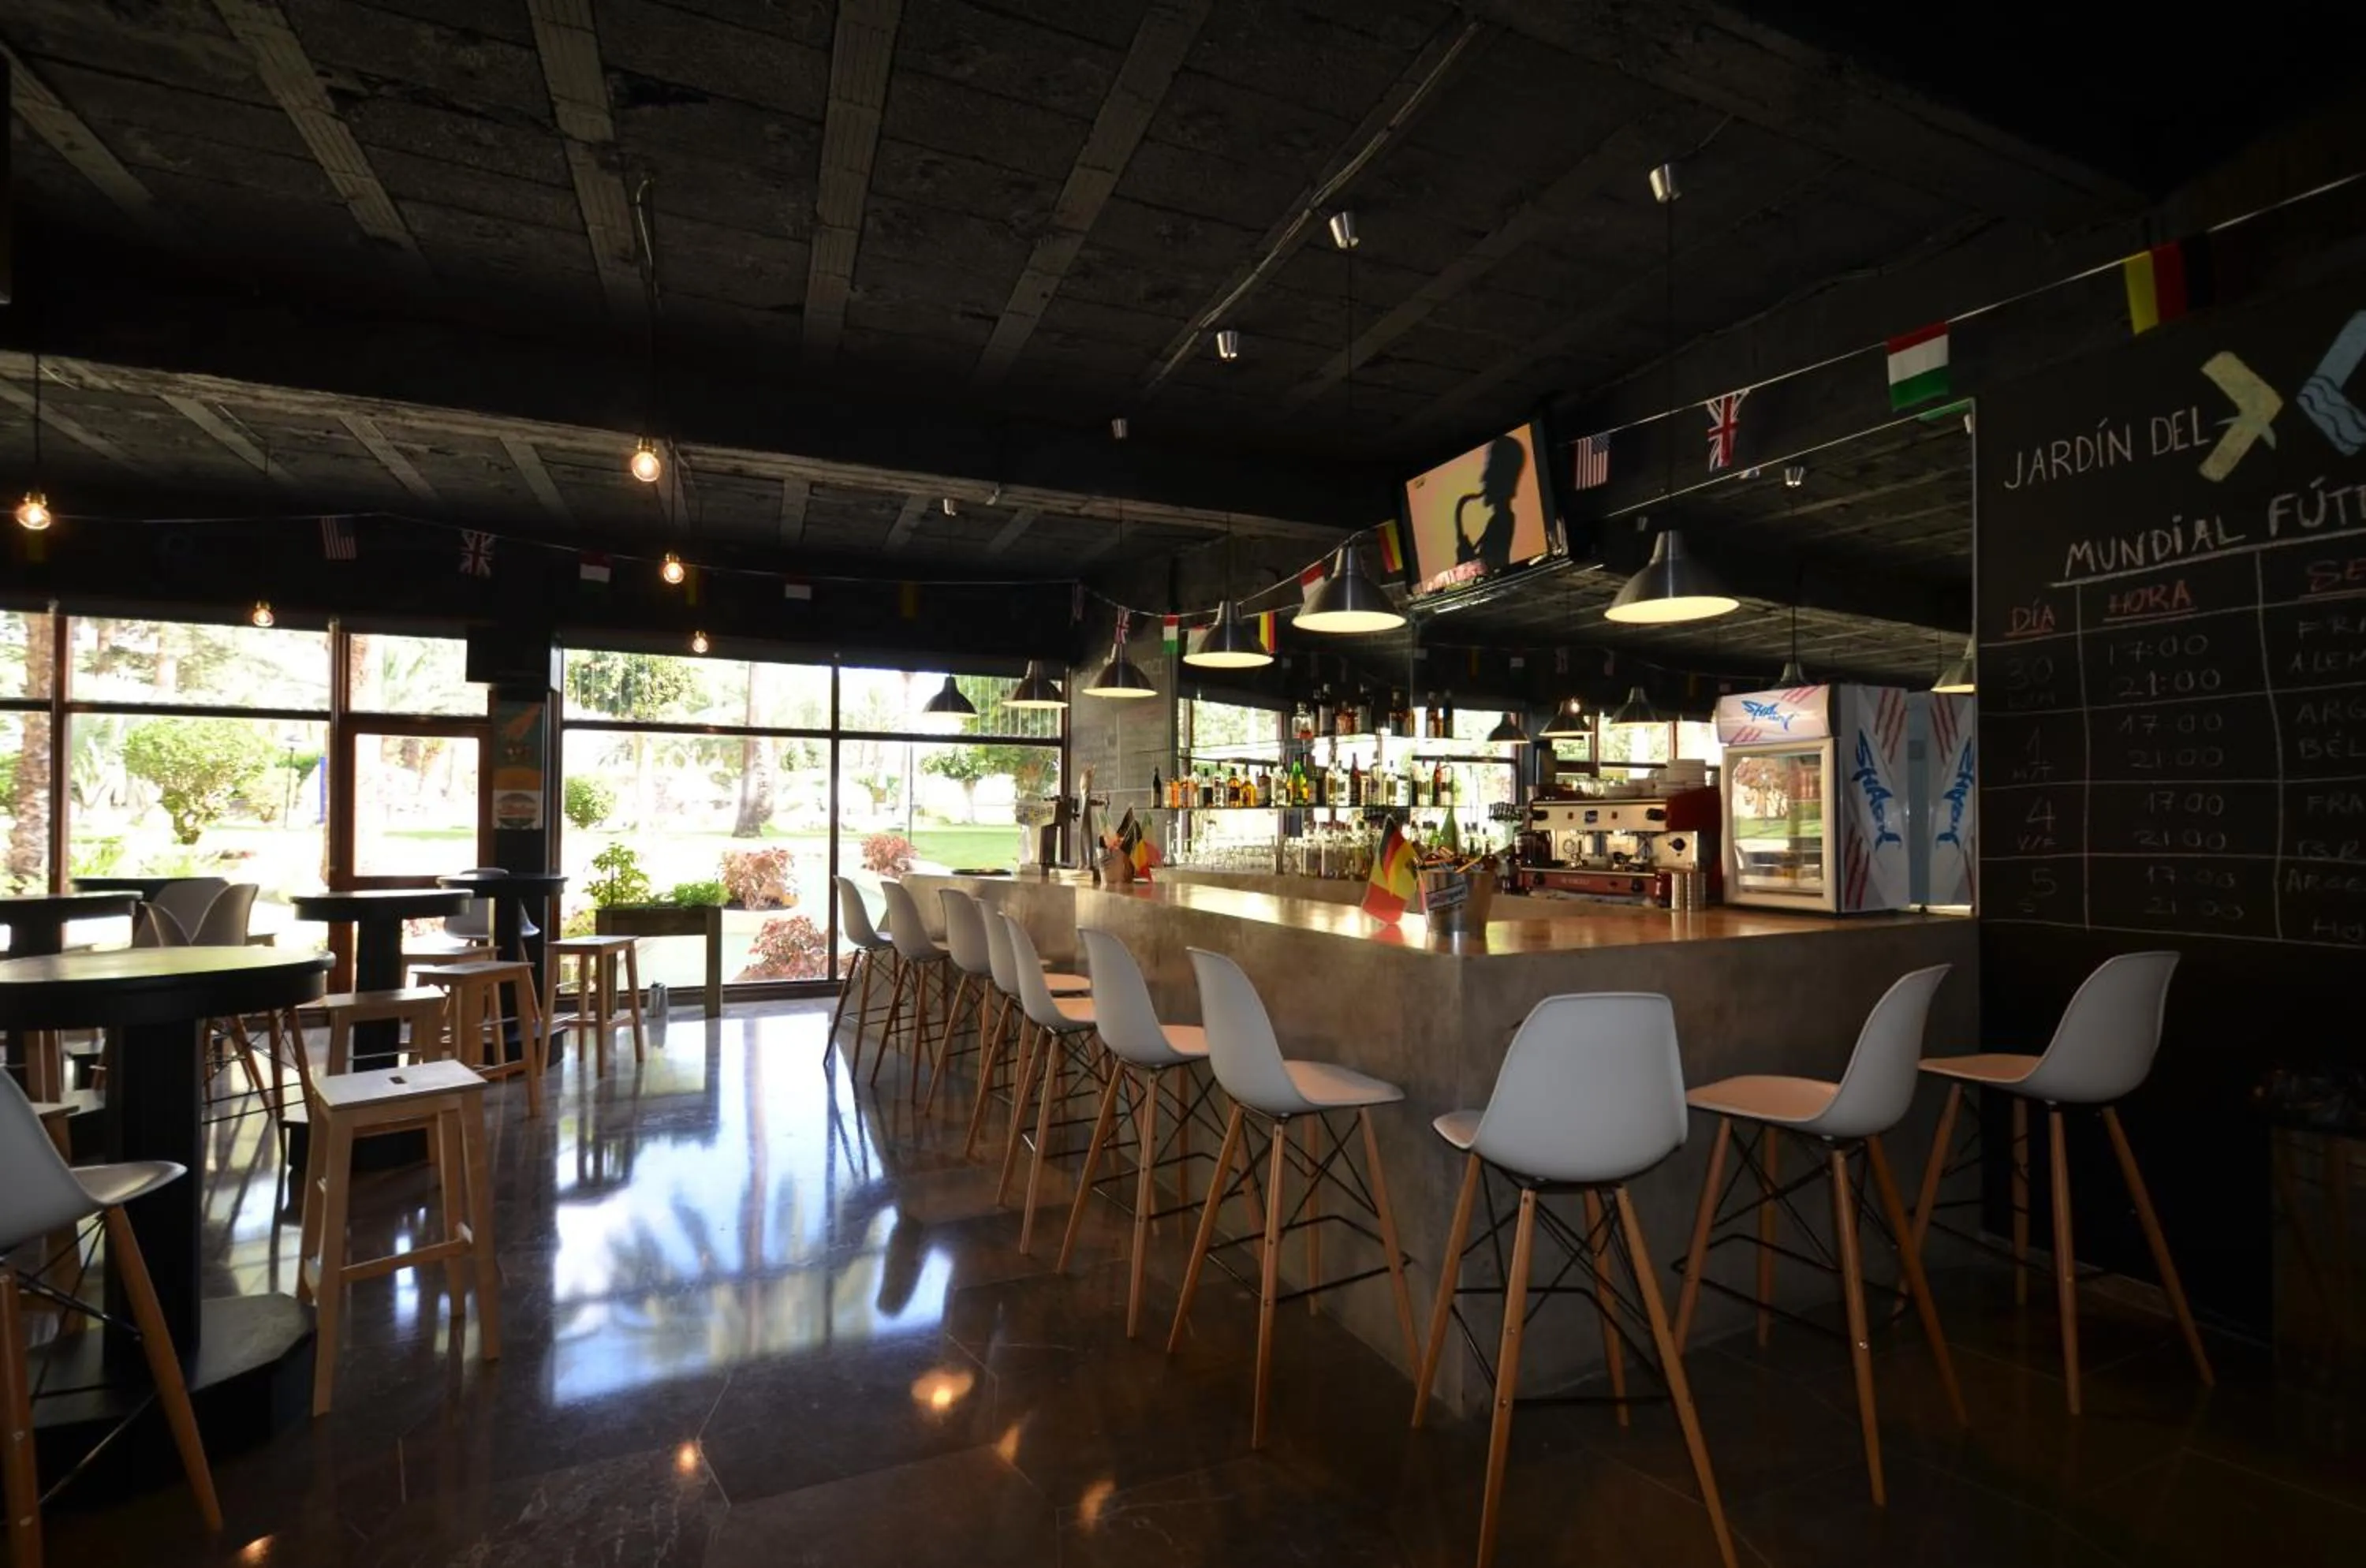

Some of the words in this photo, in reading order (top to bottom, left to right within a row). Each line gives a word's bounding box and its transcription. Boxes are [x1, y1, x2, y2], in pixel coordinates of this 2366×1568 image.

[2003, 416, 2133, 490] JARDÍN
[2151, 405, 2211, 457] DEL
[2011, 592, 2057, 632] DÍA
[2107, 578, 2193, 615] HORA
[2108, 633, 2209, 666] 17:00
[2110, 667, 2222, 697] 21:00
[2025, 795, 2058, 833] 4
[2028, 867, 2058, 900] 5
